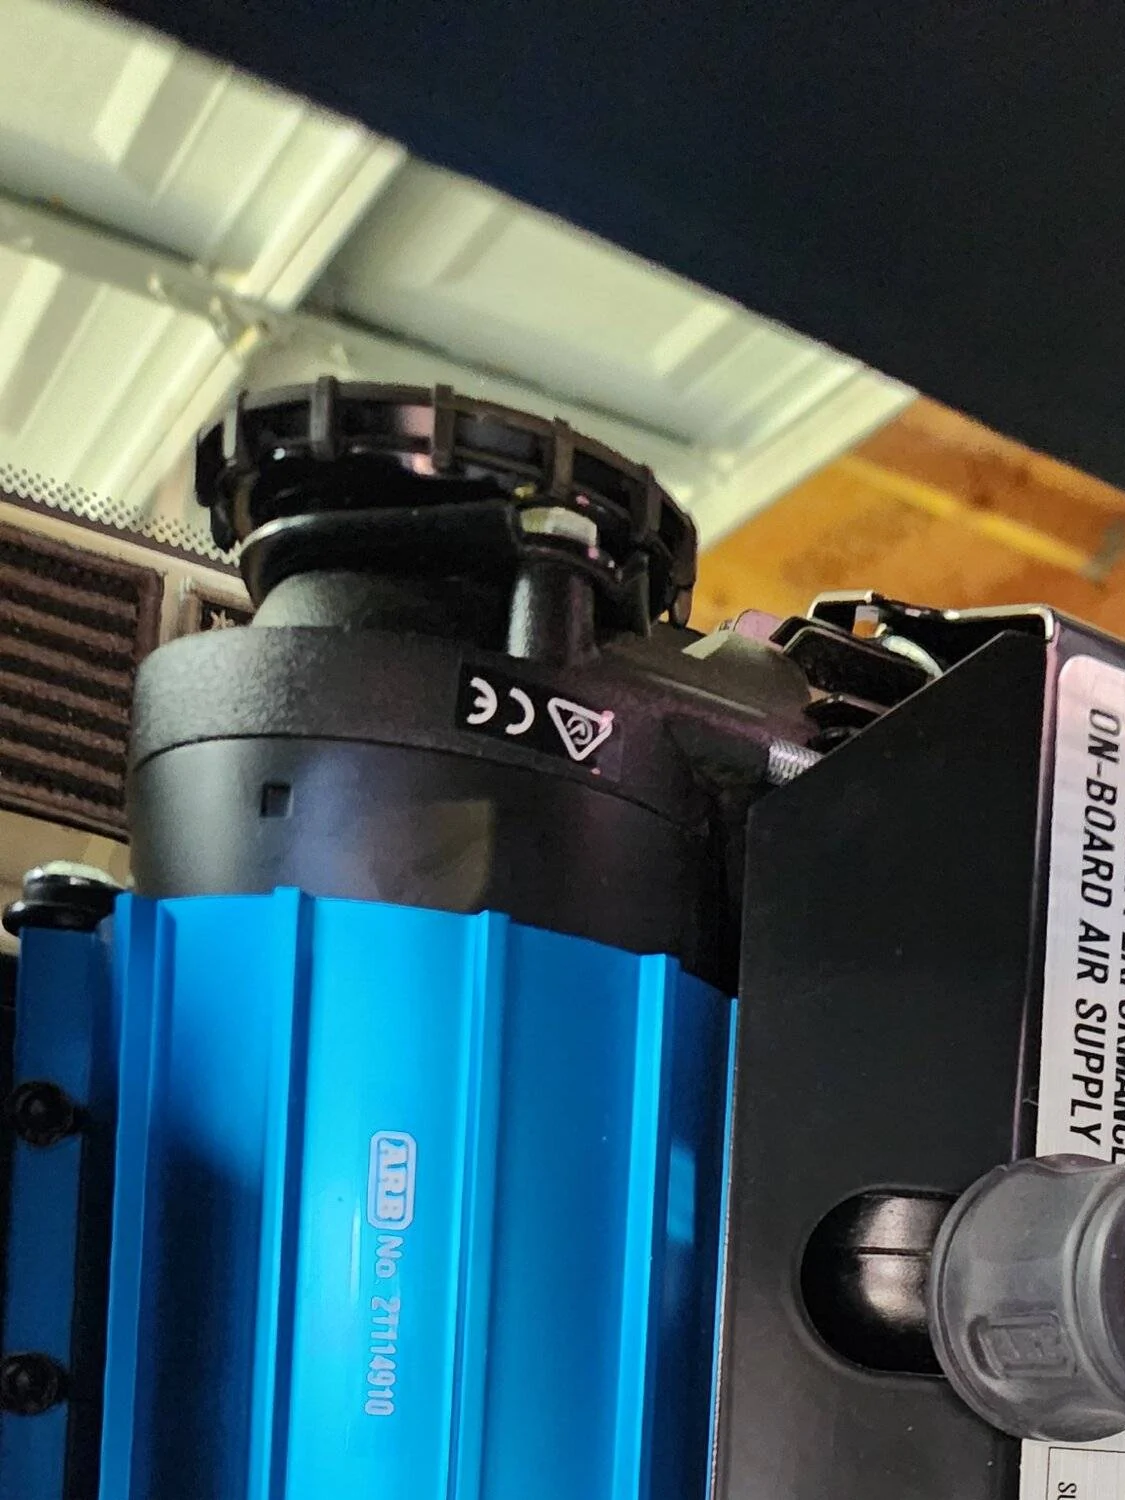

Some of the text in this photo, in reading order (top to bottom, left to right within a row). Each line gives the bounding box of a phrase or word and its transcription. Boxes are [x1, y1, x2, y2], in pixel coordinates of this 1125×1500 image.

[1070, 707, 1121, 1147] ON-BOARD AIR SUPPLY
